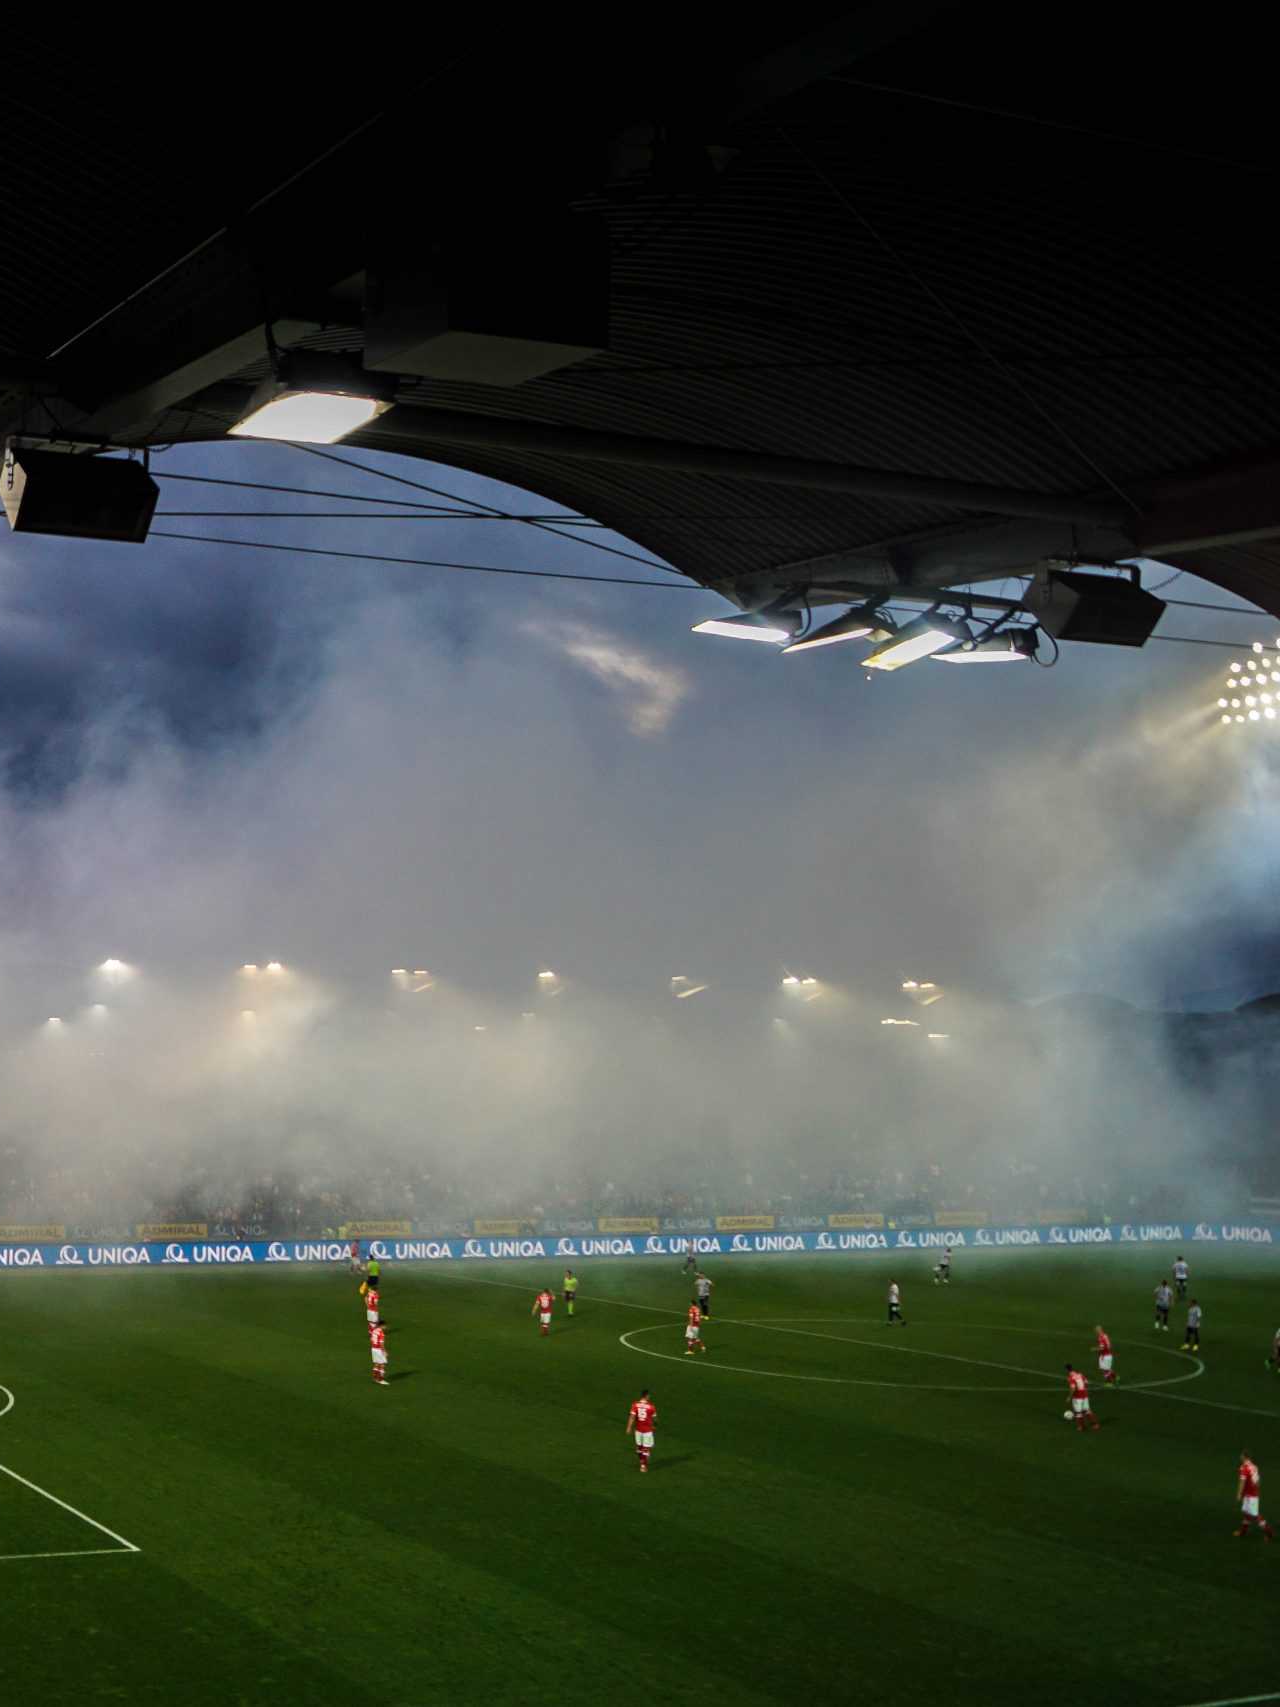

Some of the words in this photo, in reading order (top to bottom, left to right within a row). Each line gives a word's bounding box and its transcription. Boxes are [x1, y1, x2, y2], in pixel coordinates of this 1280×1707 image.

[87, 1247, 151, 1265] UNIQA
[192, 1246, 254, 1263] UNIQA
[295, 1244, 352, 1261] UNIQA
[395, 1242, 453, 1259] UNIQA
[489, 1241, 545, 1257] UNIQA
[581, 1240, 635, 1256] UNIQA
[669, 1238, 721, 1254] UNIQA
[755, 1236, 805, 1251] UNIQA
[839, 1234, 888, 1249] UNIQA
[918, 1232, 966, 1248] UNIQA
[994, 1230, 1041, 1245] UNIQA
[1068, 1227, 1113, 1243] UNIQA
[1139, 1225, 1183, 1241] UNIQA
[1221, 1226, 1272, 1243] UNIQA
